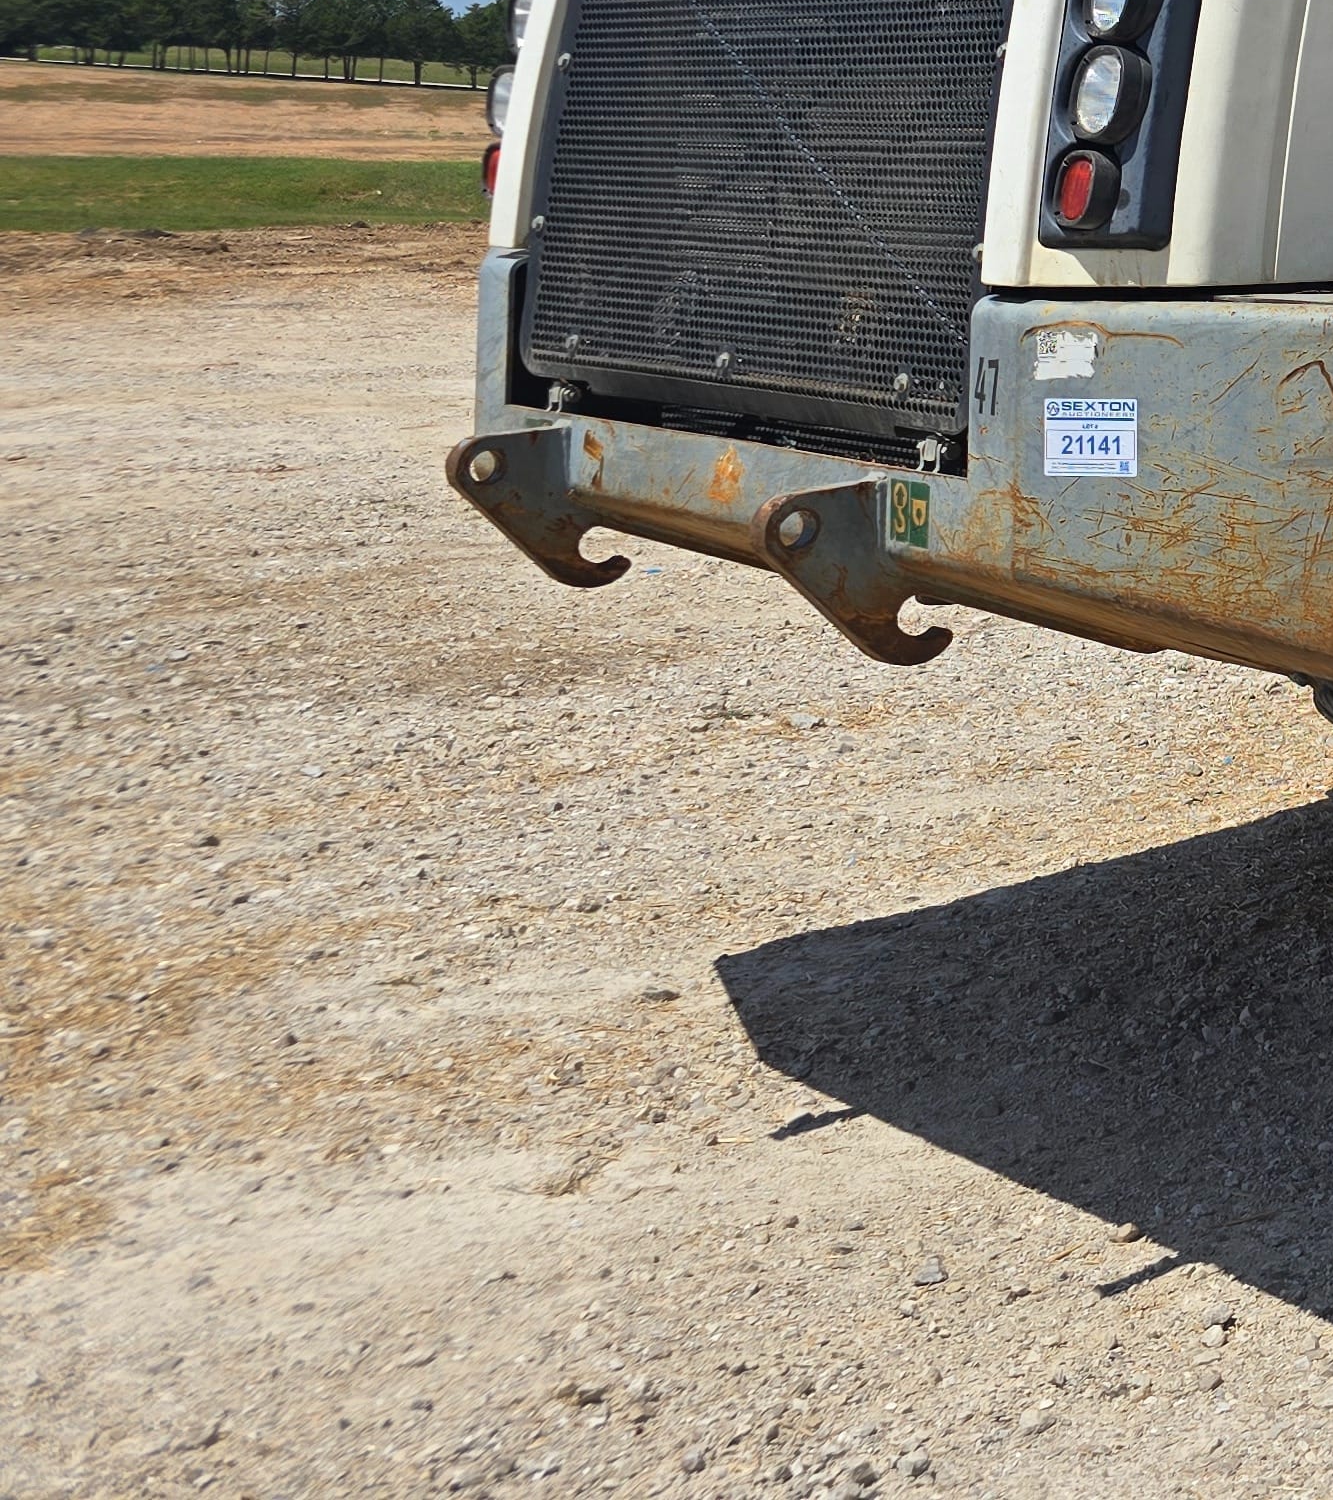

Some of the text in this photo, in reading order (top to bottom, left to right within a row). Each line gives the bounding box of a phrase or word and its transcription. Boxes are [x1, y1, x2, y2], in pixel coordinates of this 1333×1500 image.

[974, 357, 999, 416] 47
[1061, 401, 1135, 412] SEXTON
[1061, 435, 1121, 455] 21141
